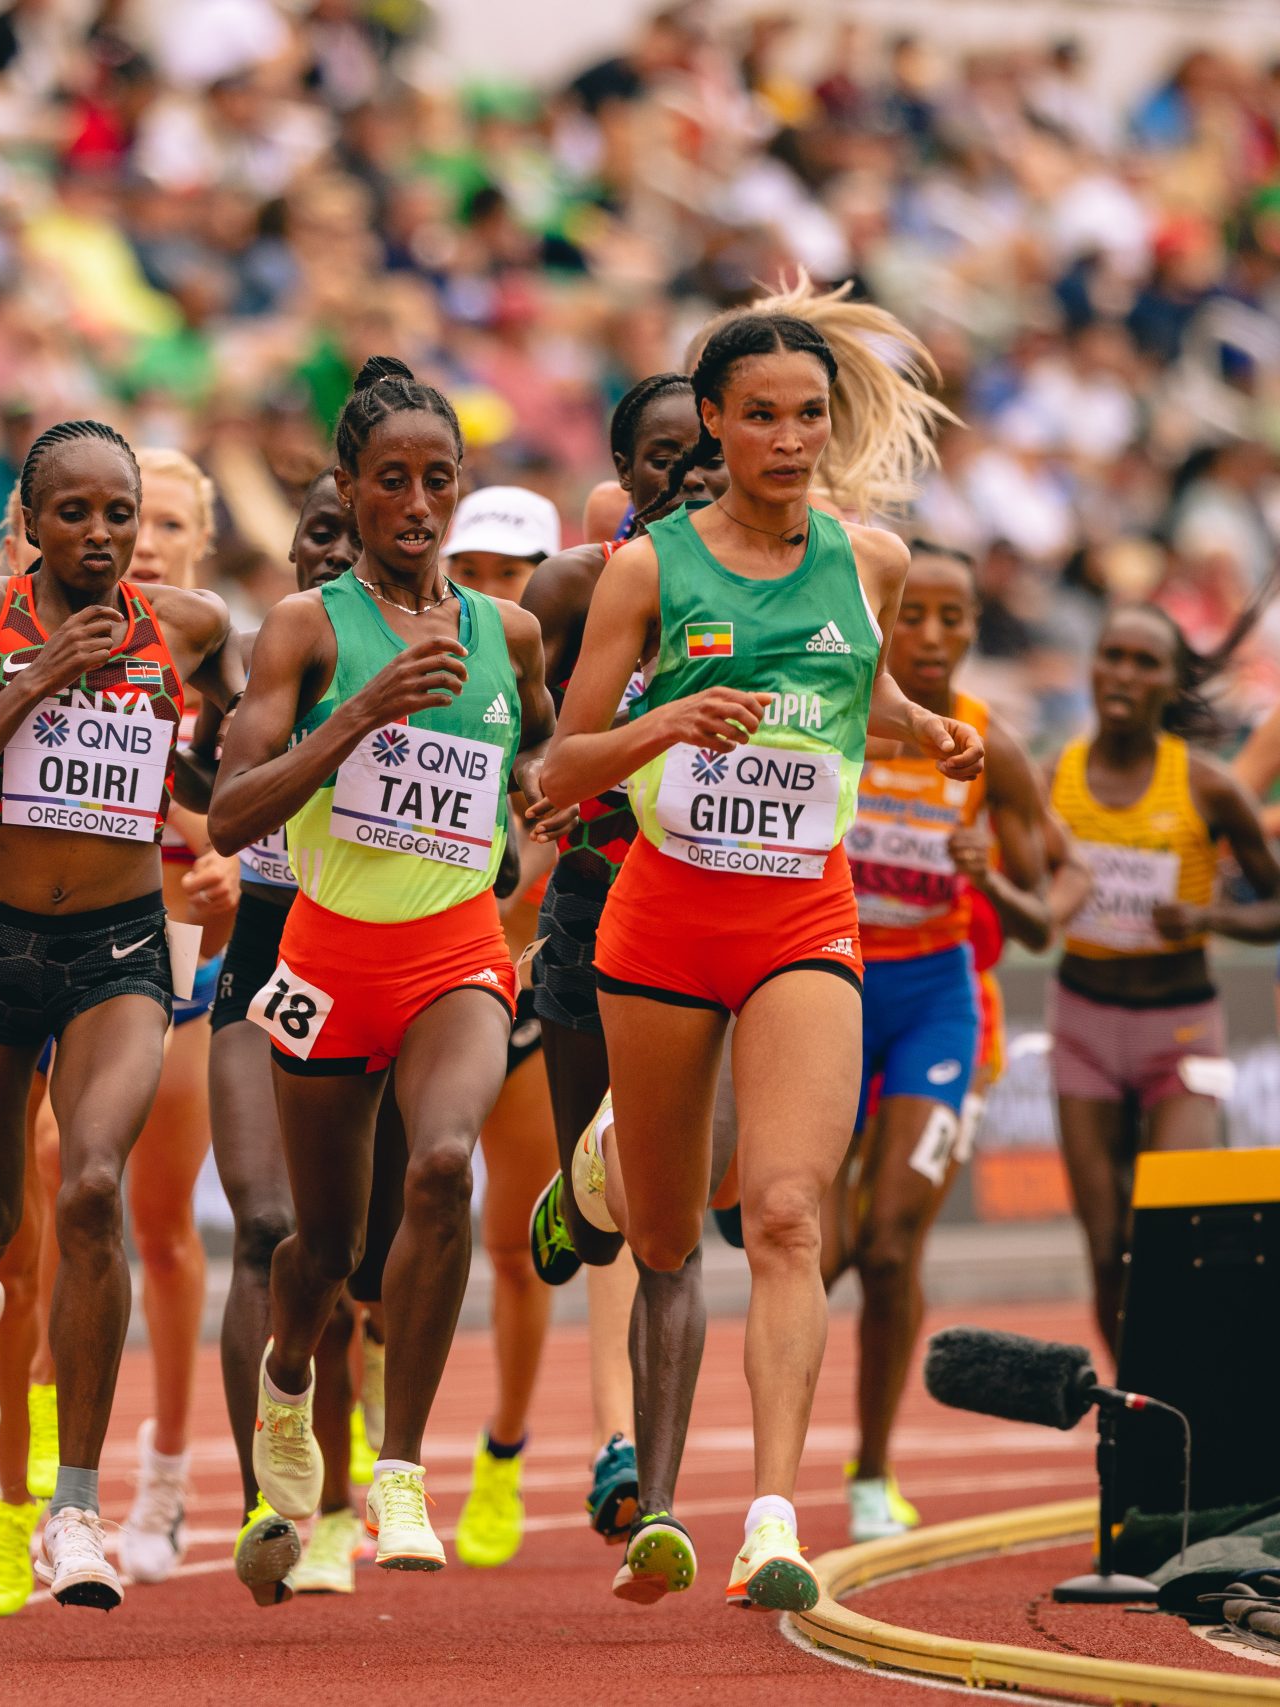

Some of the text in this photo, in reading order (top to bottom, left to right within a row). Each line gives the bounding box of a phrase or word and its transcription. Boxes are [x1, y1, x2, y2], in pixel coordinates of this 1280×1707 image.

[805, 639, 852, 655] adidas
[763, 691, 822, 730] OPIA
[77, 718, 153, 755] QNB
[38, 755, 140, 804] OBIRI
[417, 741, 489, 782] QNB
[736, 755, 817, 792] QNB
[27, 805, 139, 837] OREGON22
[378, 774, 473, 831] TAYE
[689, 793, 806, 841] GIDEY
[356, 823, 471, 865] OREGON22
[687, 844, 801, 875] OREGON22
[250, 856, 296, 882] OREG
[263, 977, 318, 1040] 18
